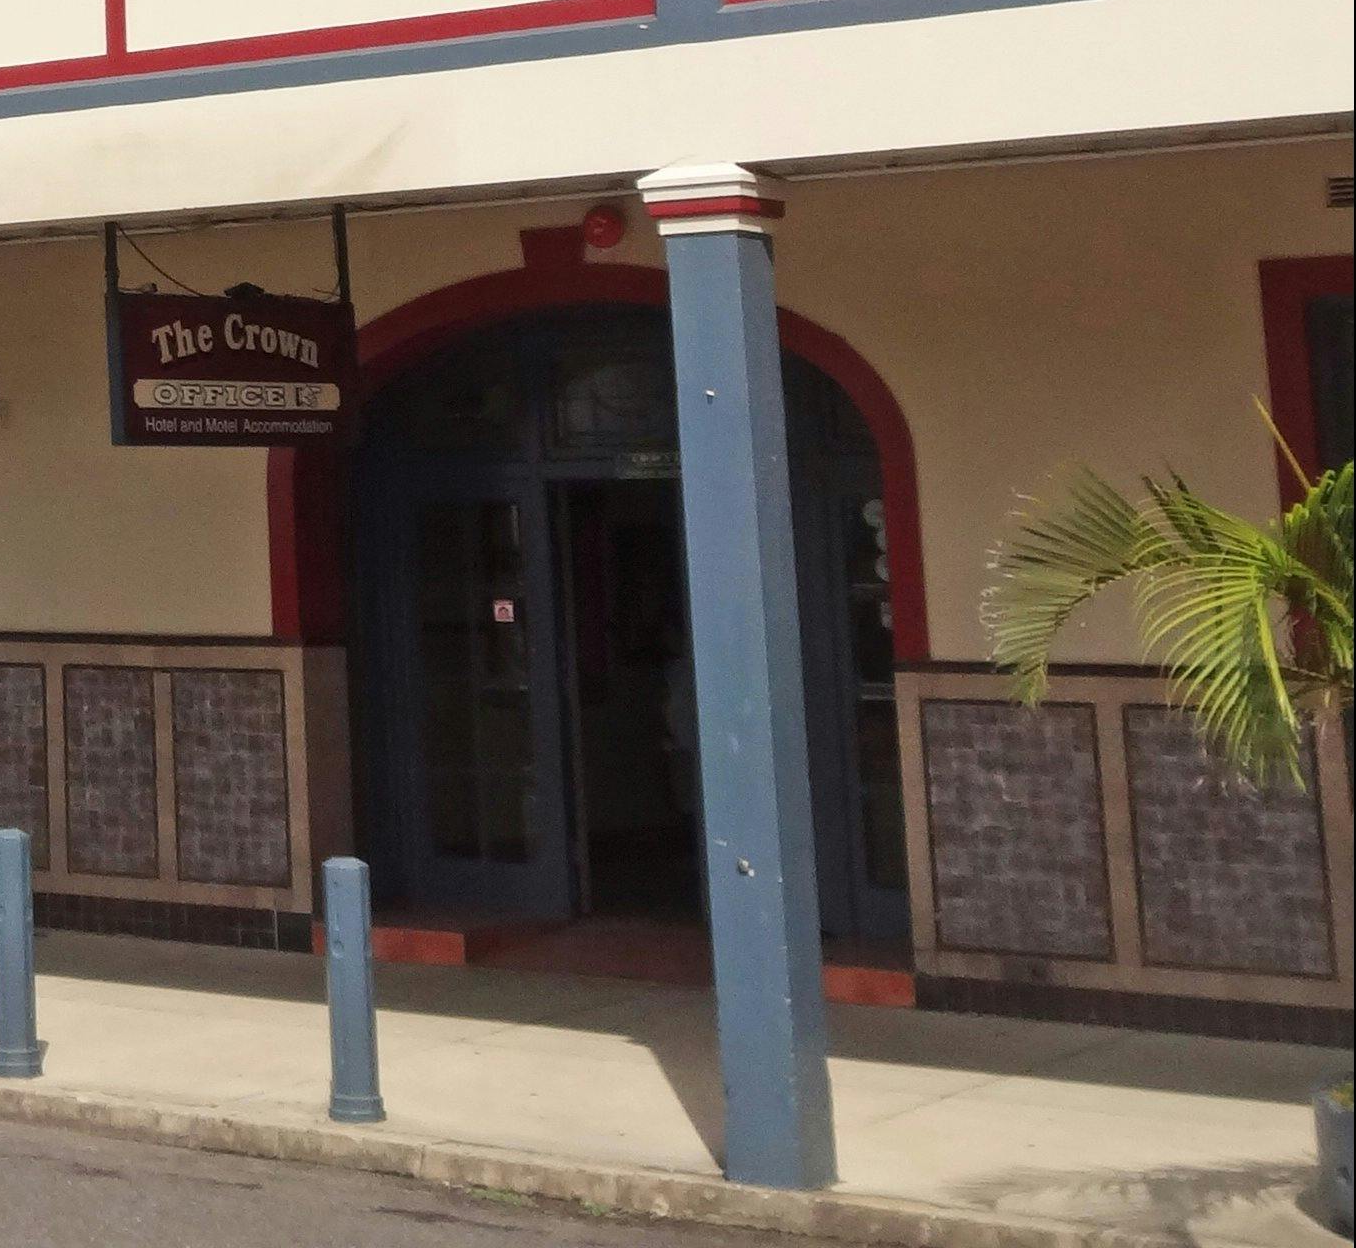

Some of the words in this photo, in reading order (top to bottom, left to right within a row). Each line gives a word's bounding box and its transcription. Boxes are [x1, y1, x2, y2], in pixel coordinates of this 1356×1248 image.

[151, 319, 213, 364] The
[223, 313, 319, 368] Crown
[154, 383, 287, 407] OFFICE
[145, 416, 178, 433] Hotel
[180, 418, 203, 433] and
[205, 417, 238, 434] Motel
[243, 418, 333, 434] Accommodation
